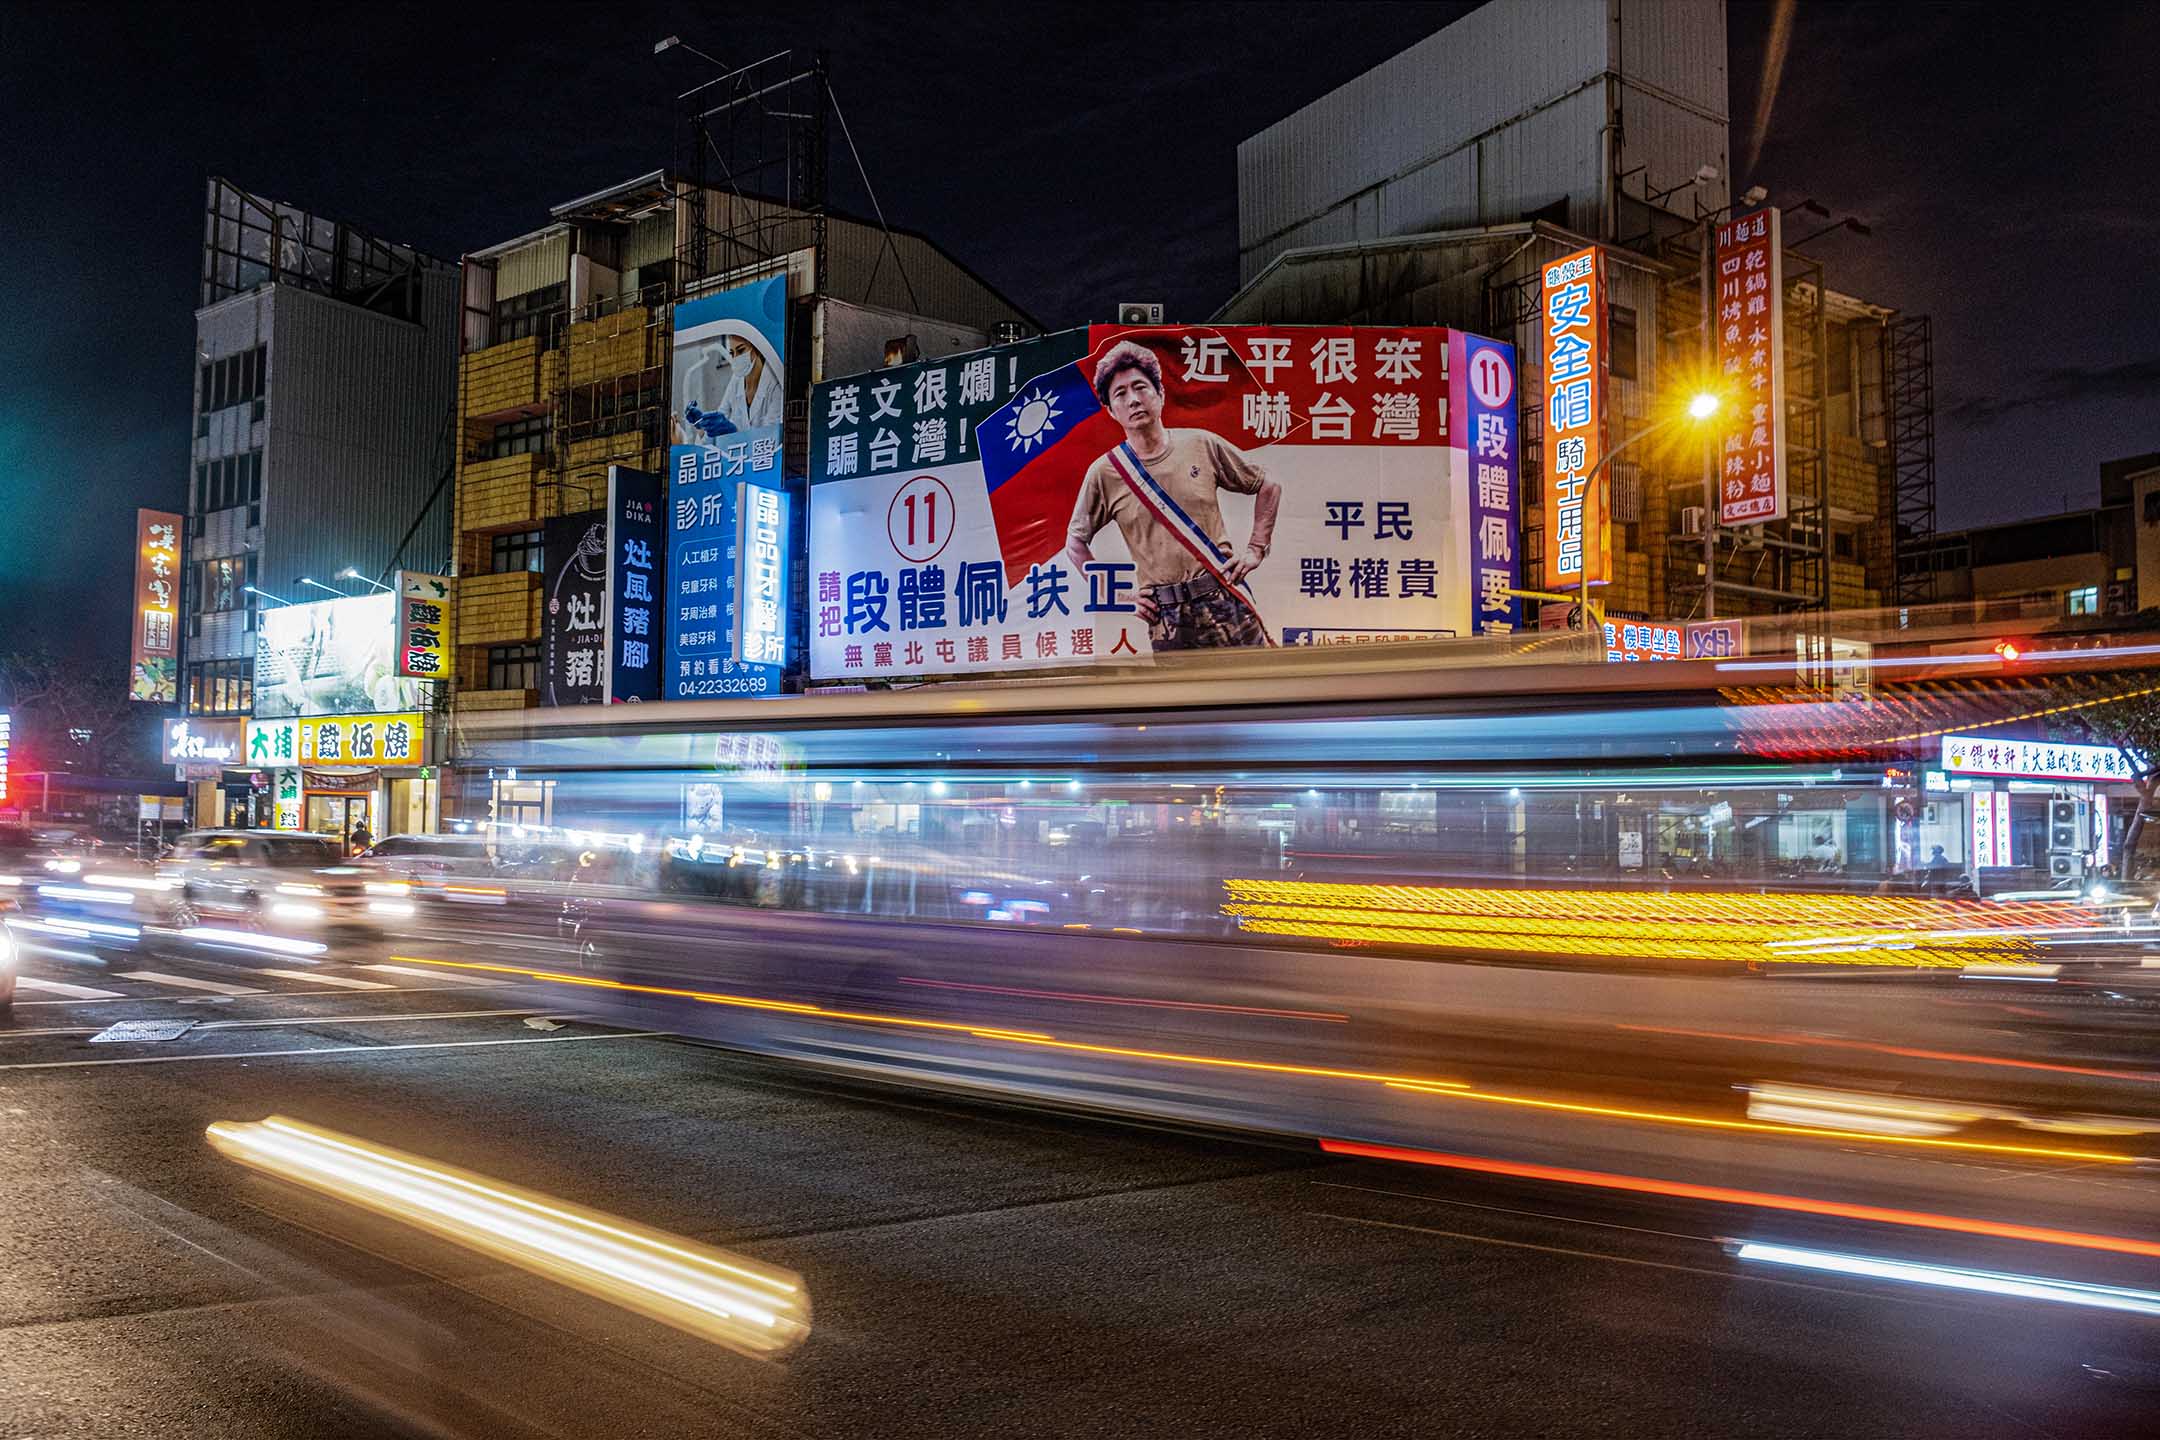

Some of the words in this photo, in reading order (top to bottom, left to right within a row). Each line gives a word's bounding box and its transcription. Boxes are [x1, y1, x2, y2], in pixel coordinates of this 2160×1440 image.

[1181, 336, 1449, 385] 近平很笨!
[1550, 285, 1590, 429] 安全帽
[827, 356, 1018, 430] 英文很爛!
[1479, 359, 1501, 398] 11
[1242, 391, 1448, 440] 嚇台灣!
[678, 438, 776, 485] 晶品牙醫
[826, 418, 968, 477] 騙台灣!
[626, 500, 643, 511] JIA
[626, 511, 651, 523] DIKA
[677, 493, 722, 530] 診所
[904, 492, 937, 545] 11
[1324, 501, 1414, 541] 平民
[1558, 438, 1585, 572] 騎士用品
[682, 548, 719, 566] 人工植牙
[754, 492, 779, 632] 晶品牙醫
[681, 577, 717, 594] 兒童牙科
[843, 560, 1137, 635] 段體佩扶正
[1300, 558, 1439, 599] 戰權貴
[622, 539, 652, 669] 灶風豬腳
[680, 605, 717, 621] 牙周治療
[819, 571, 842, 637] 請把
[408, 602, 441, 672] 鐵板燒
[680, 630, 716, 647] 美容牙科
[744, 632, 785, 662] 診所
[845, 628, 1138, 668] 無黨北屯議員候選人
[679, 677, 767, 696] 04-22332689
[319, 722, 408, 758] 鐵板燒
